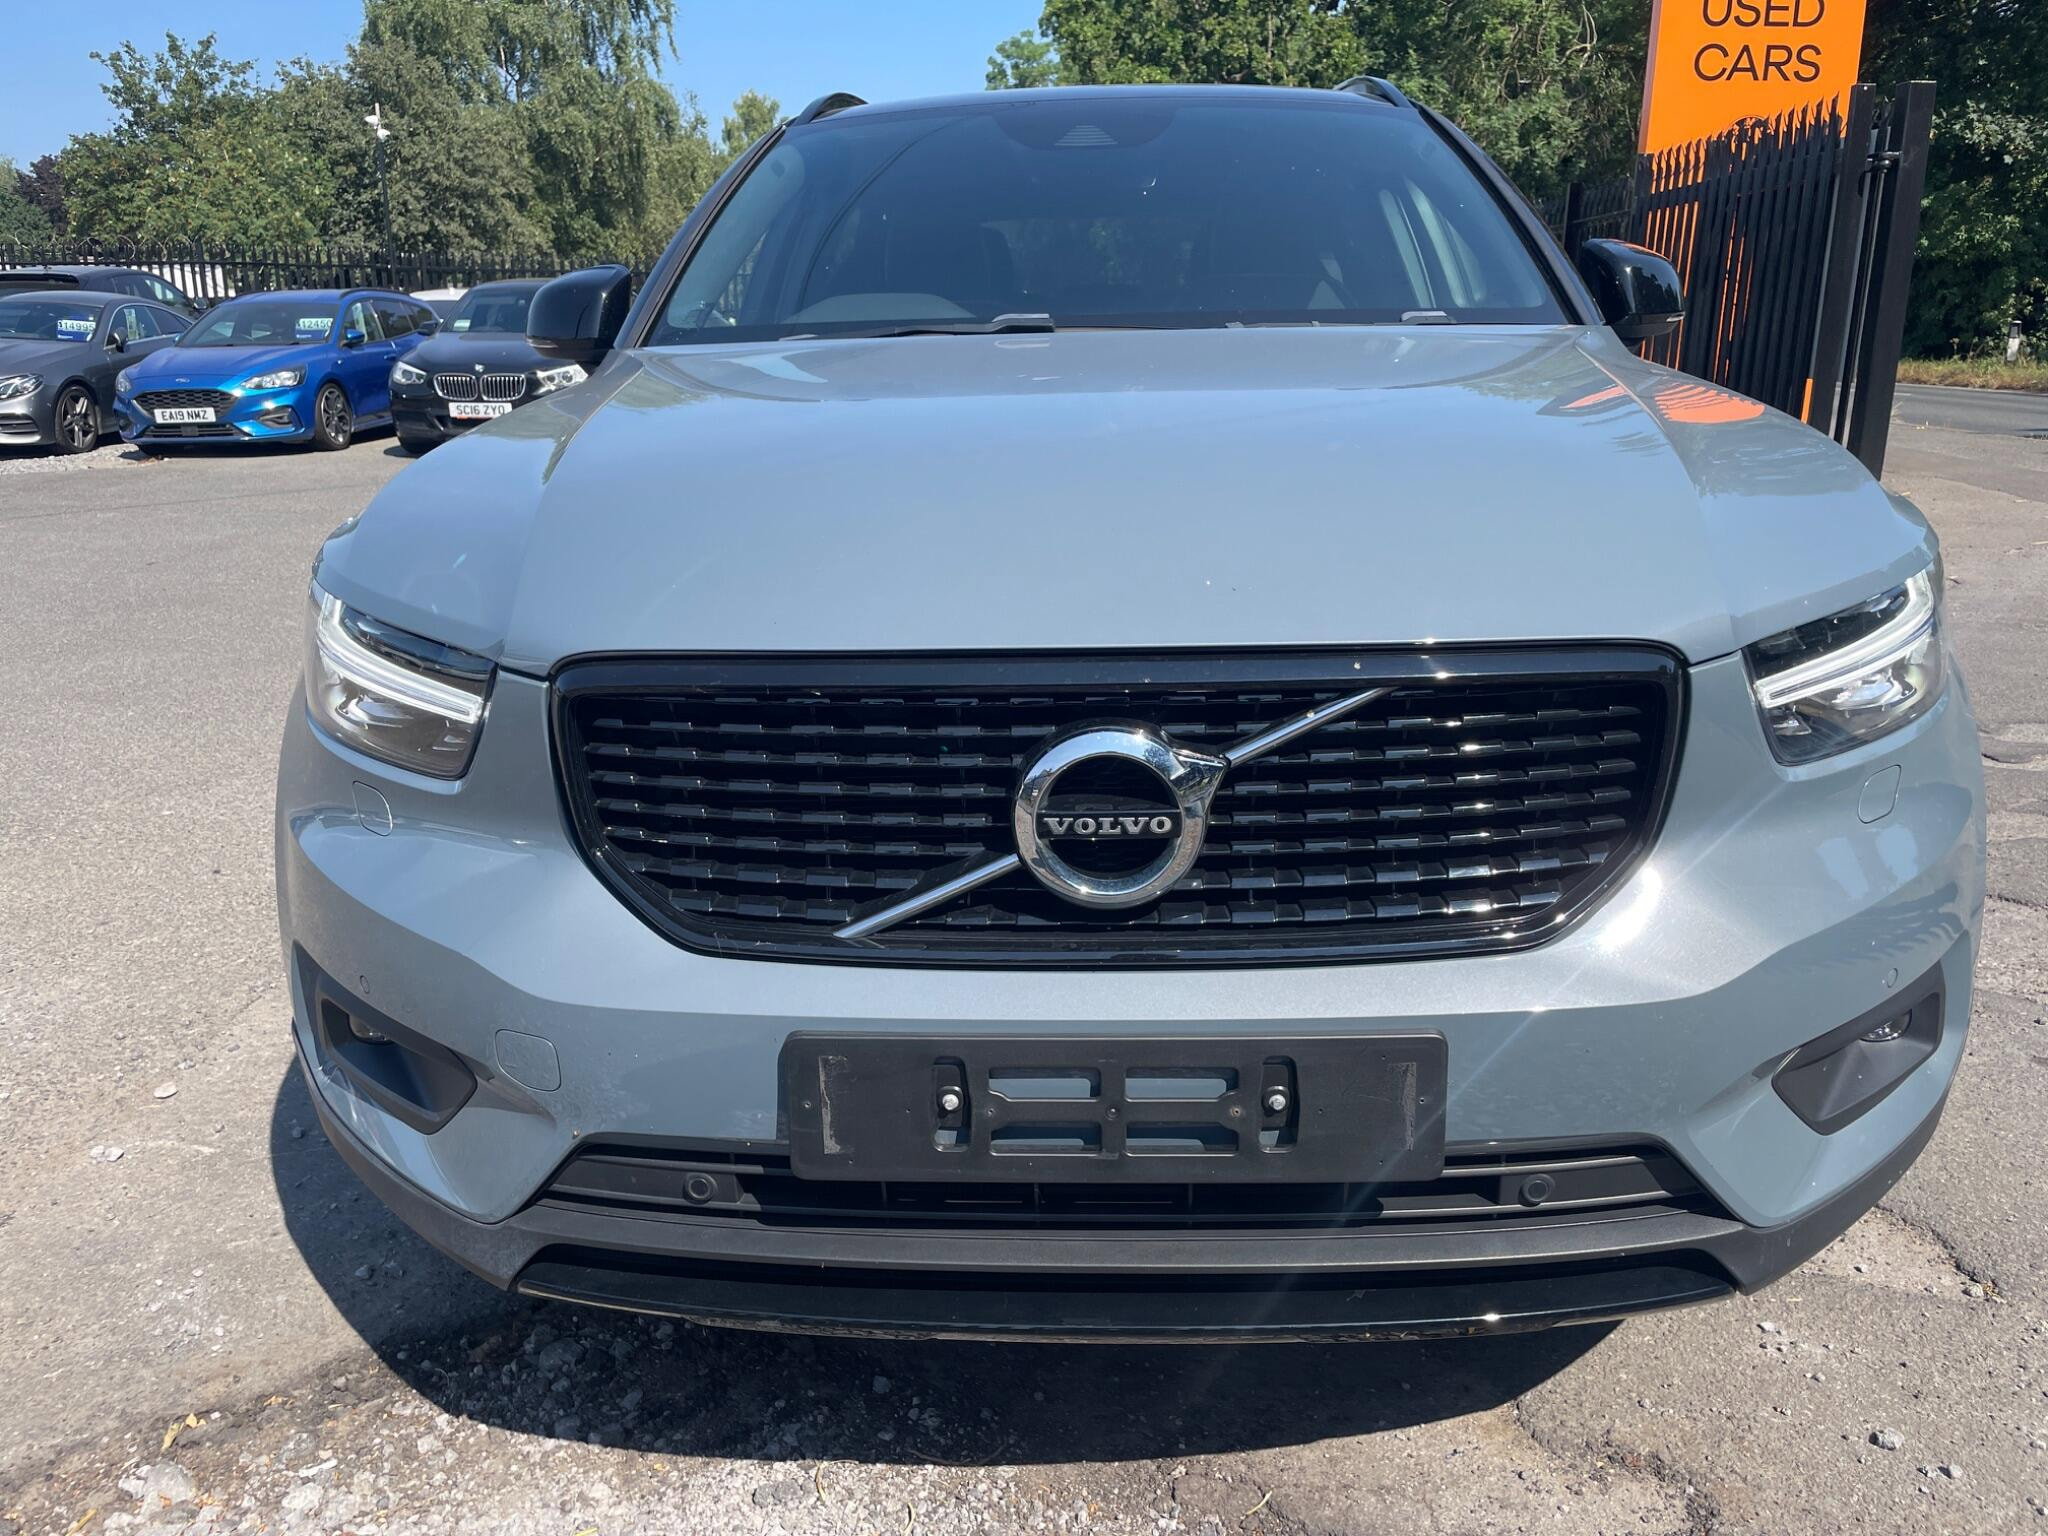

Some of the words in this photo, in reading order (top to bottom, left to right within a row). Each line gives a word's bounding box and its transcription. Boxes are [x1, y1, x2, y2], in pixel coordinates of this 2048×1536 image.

[1702, 0, 1825, 27] USED
[1693, 43, 1822, 82] CARS
[161, 410, 185, 421] EA19
[187, 409, 209, 420] NMZ
[456, 404, 480, 415] SC16
[1043, 816, 1172, 835] VOLVO
